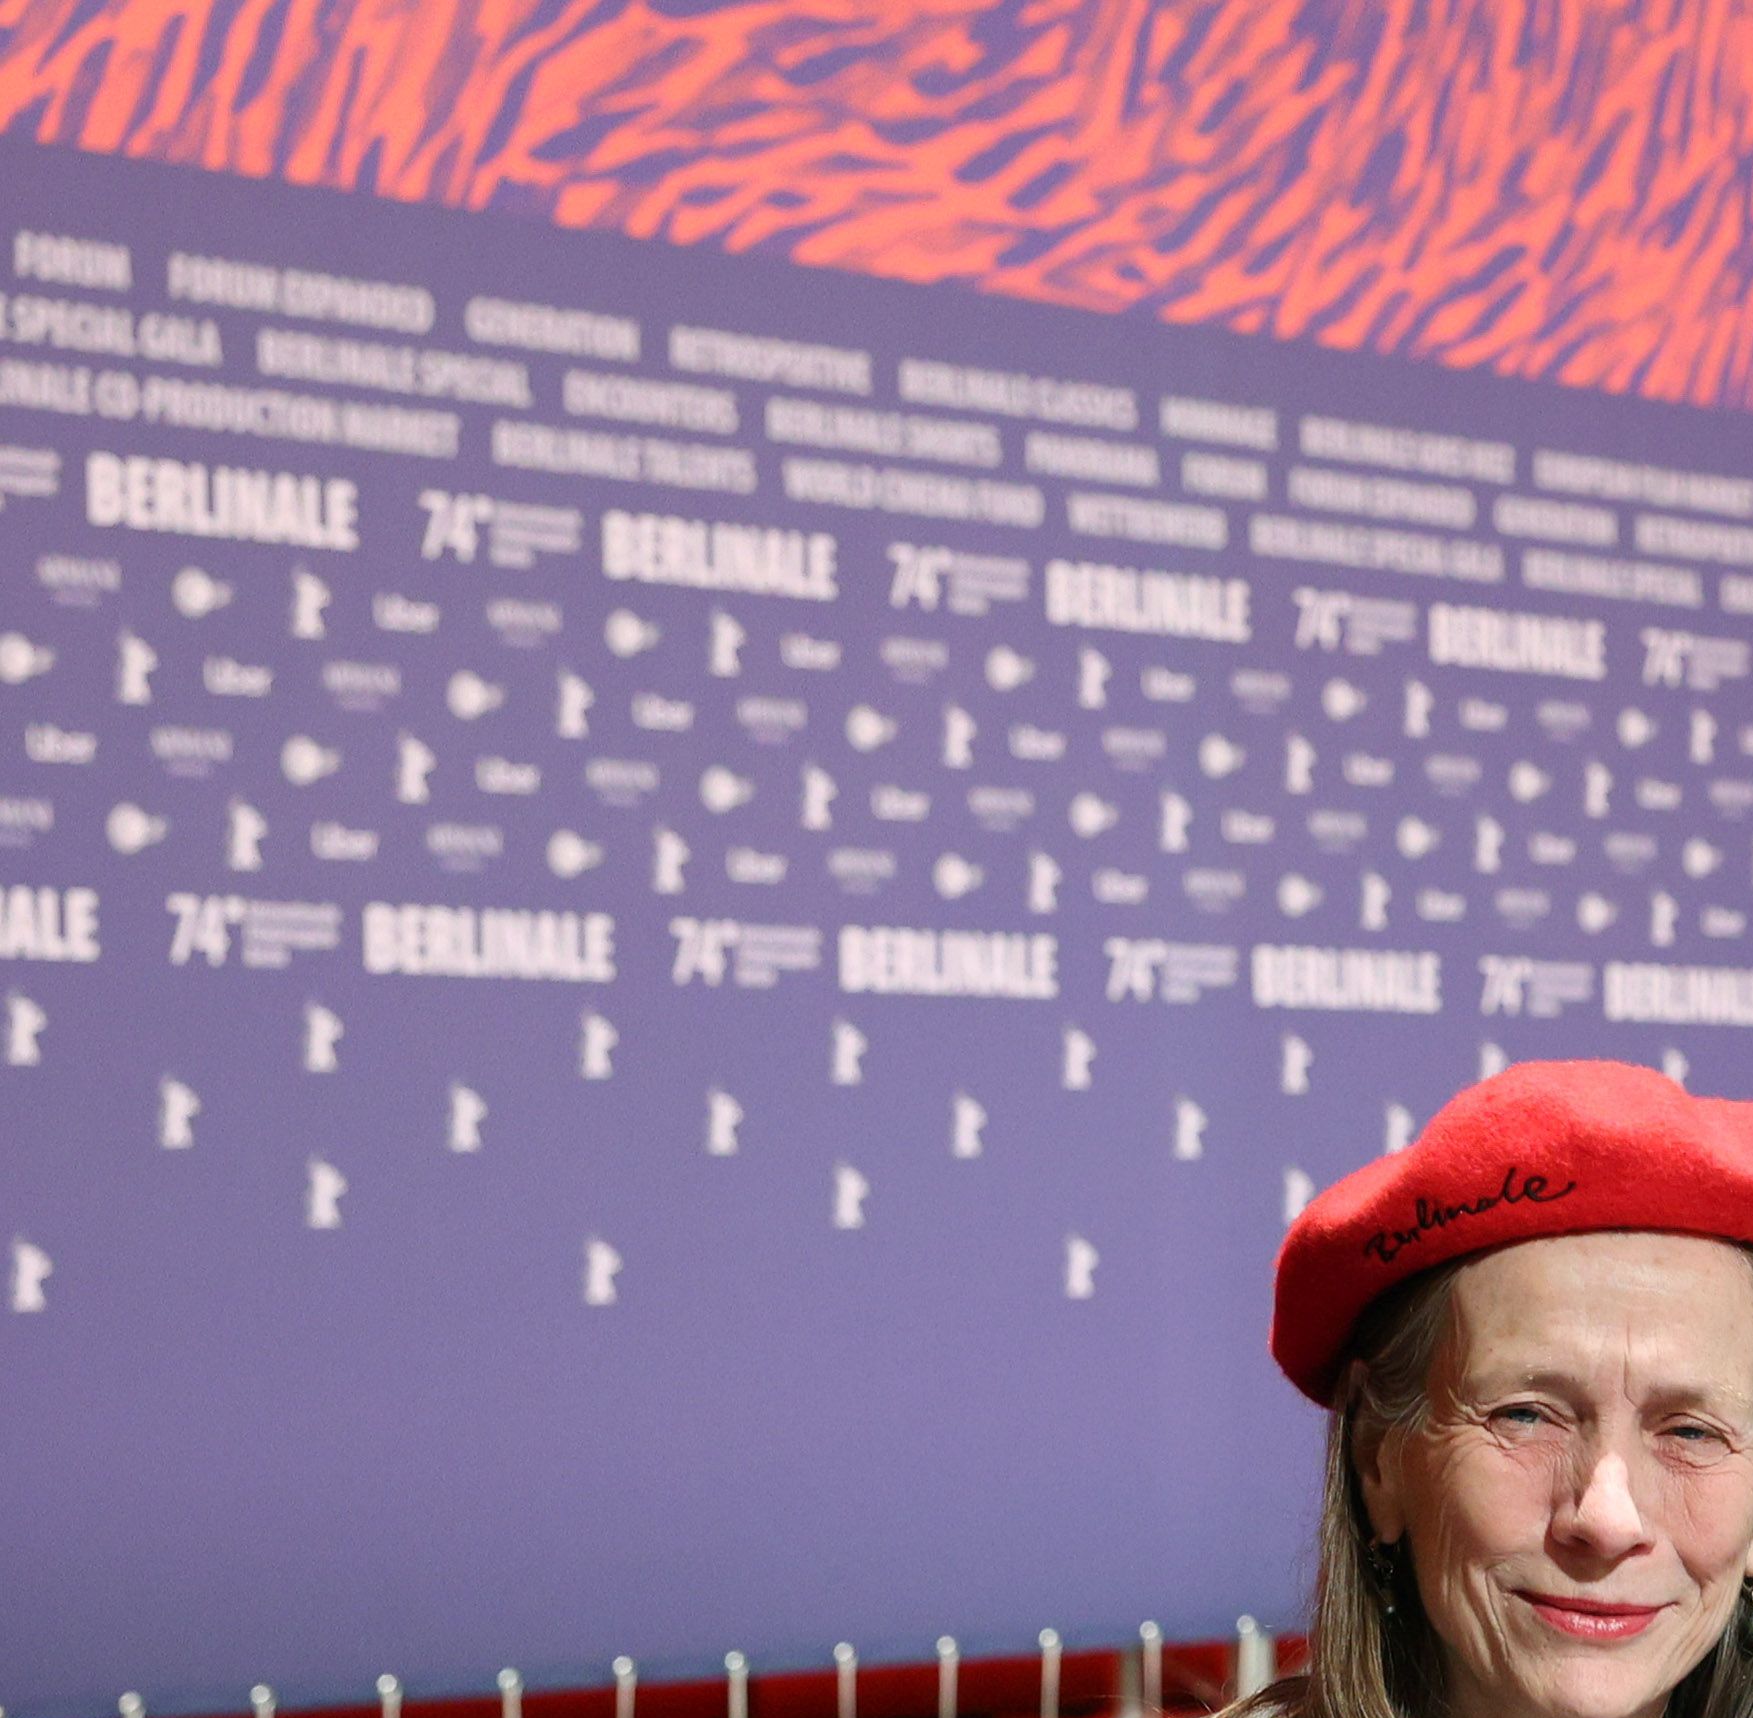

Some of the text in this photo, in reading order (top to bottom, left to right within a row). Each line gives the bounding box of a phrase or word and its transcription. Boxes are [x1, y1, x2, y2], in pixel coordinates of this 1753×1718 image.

[168, 253, 281, 310] FORUM
[86, 452, 359, 551] BERLINALE
[602, 510, 838, 601] BERLINALE
[1046, 560, 1251, 643] BERLINALE
[1429, 603, 1606, 680] BERLINALE
[0, 885, 100, 962] ALE
[363, 902, 615, 982] BERLINALE
[838, 925, 1058, 999] BERLINALE
[1252, 944, 1442, 1013] BERLINALE
[1364, 1167, 1577, 1263] Berlinale
